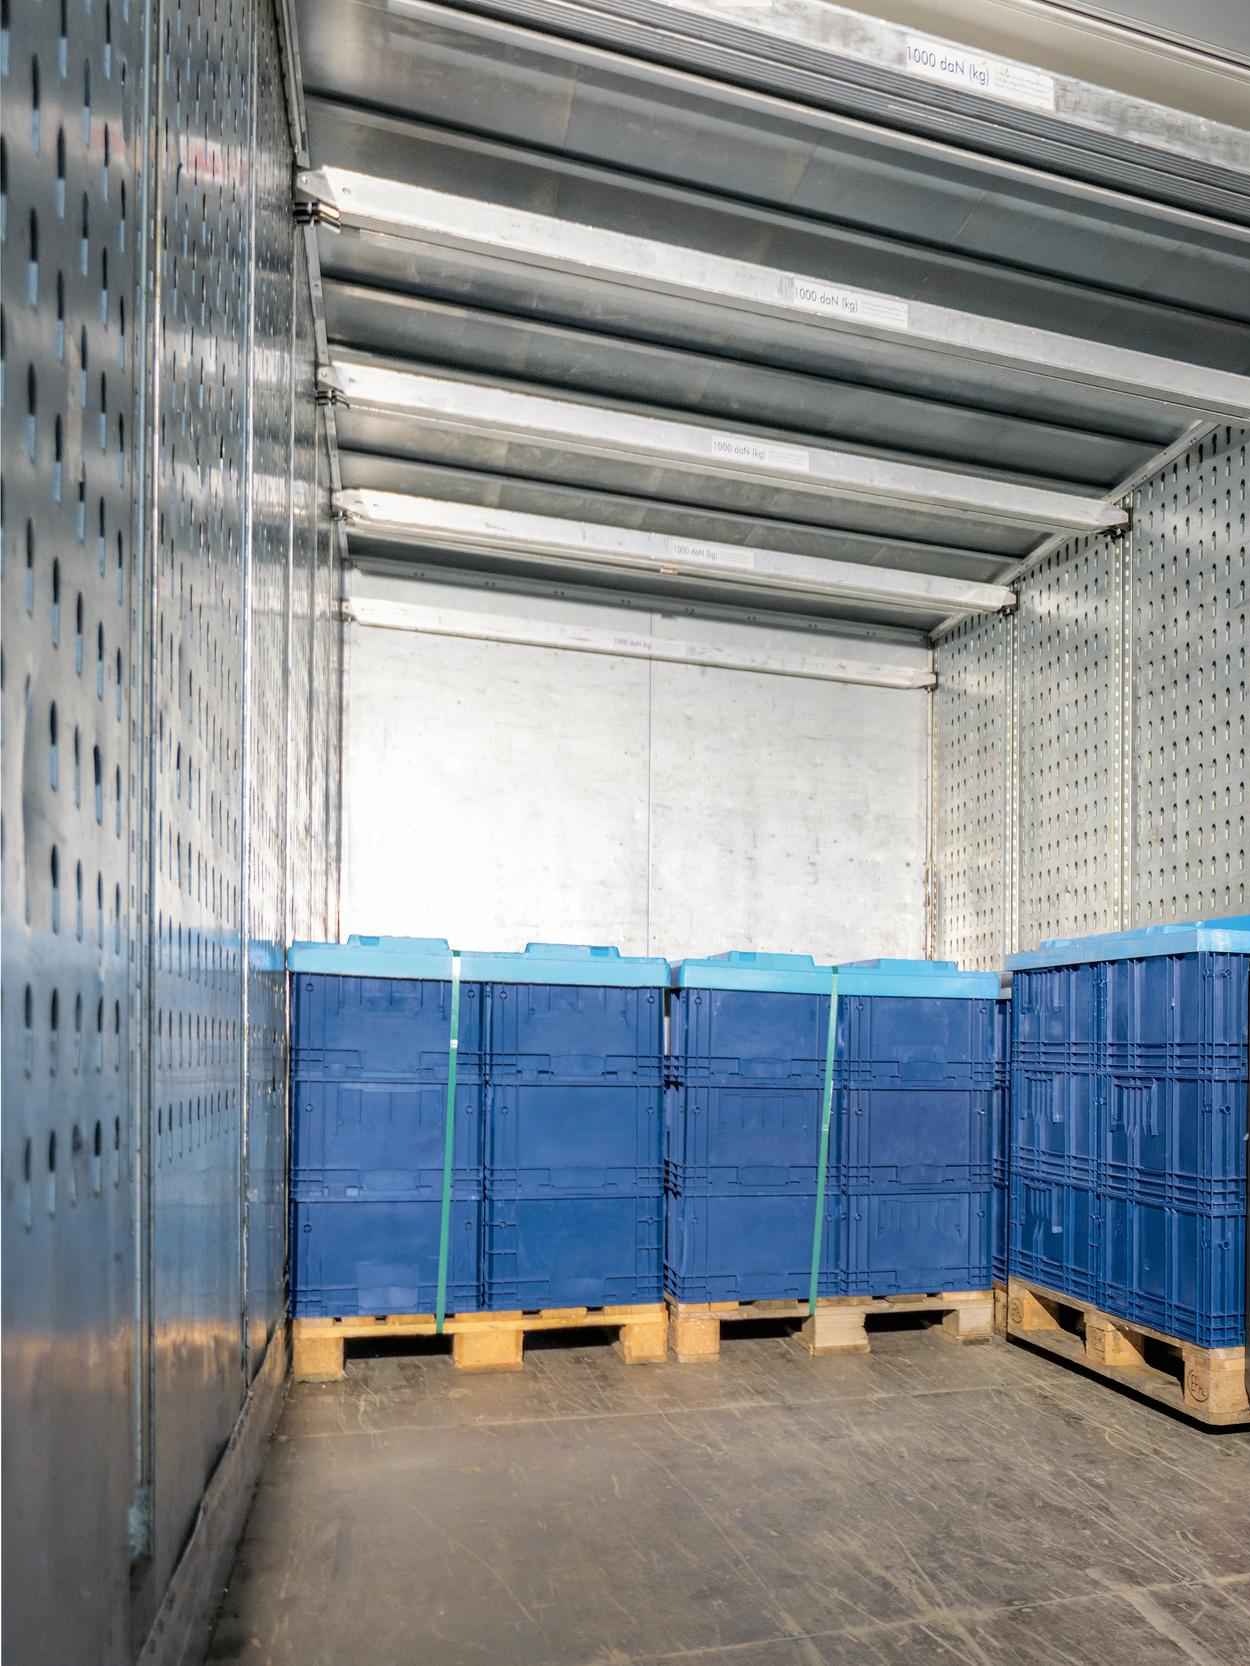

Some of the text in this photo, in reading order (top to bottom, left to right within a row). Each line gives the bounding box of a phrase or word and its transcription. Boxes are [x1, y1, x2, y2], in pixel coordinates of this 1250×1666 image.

[907, 46, 936, 68] 1000
[940, 56, 964, 75] daN
[969, 63, 989, 87] (kg)
[795, 287, 817, 302] 1000
[820, 293, 839, 306] daN
[842, 297, 858, 313] (kg)
[713, 441, 733, 453] 1000
